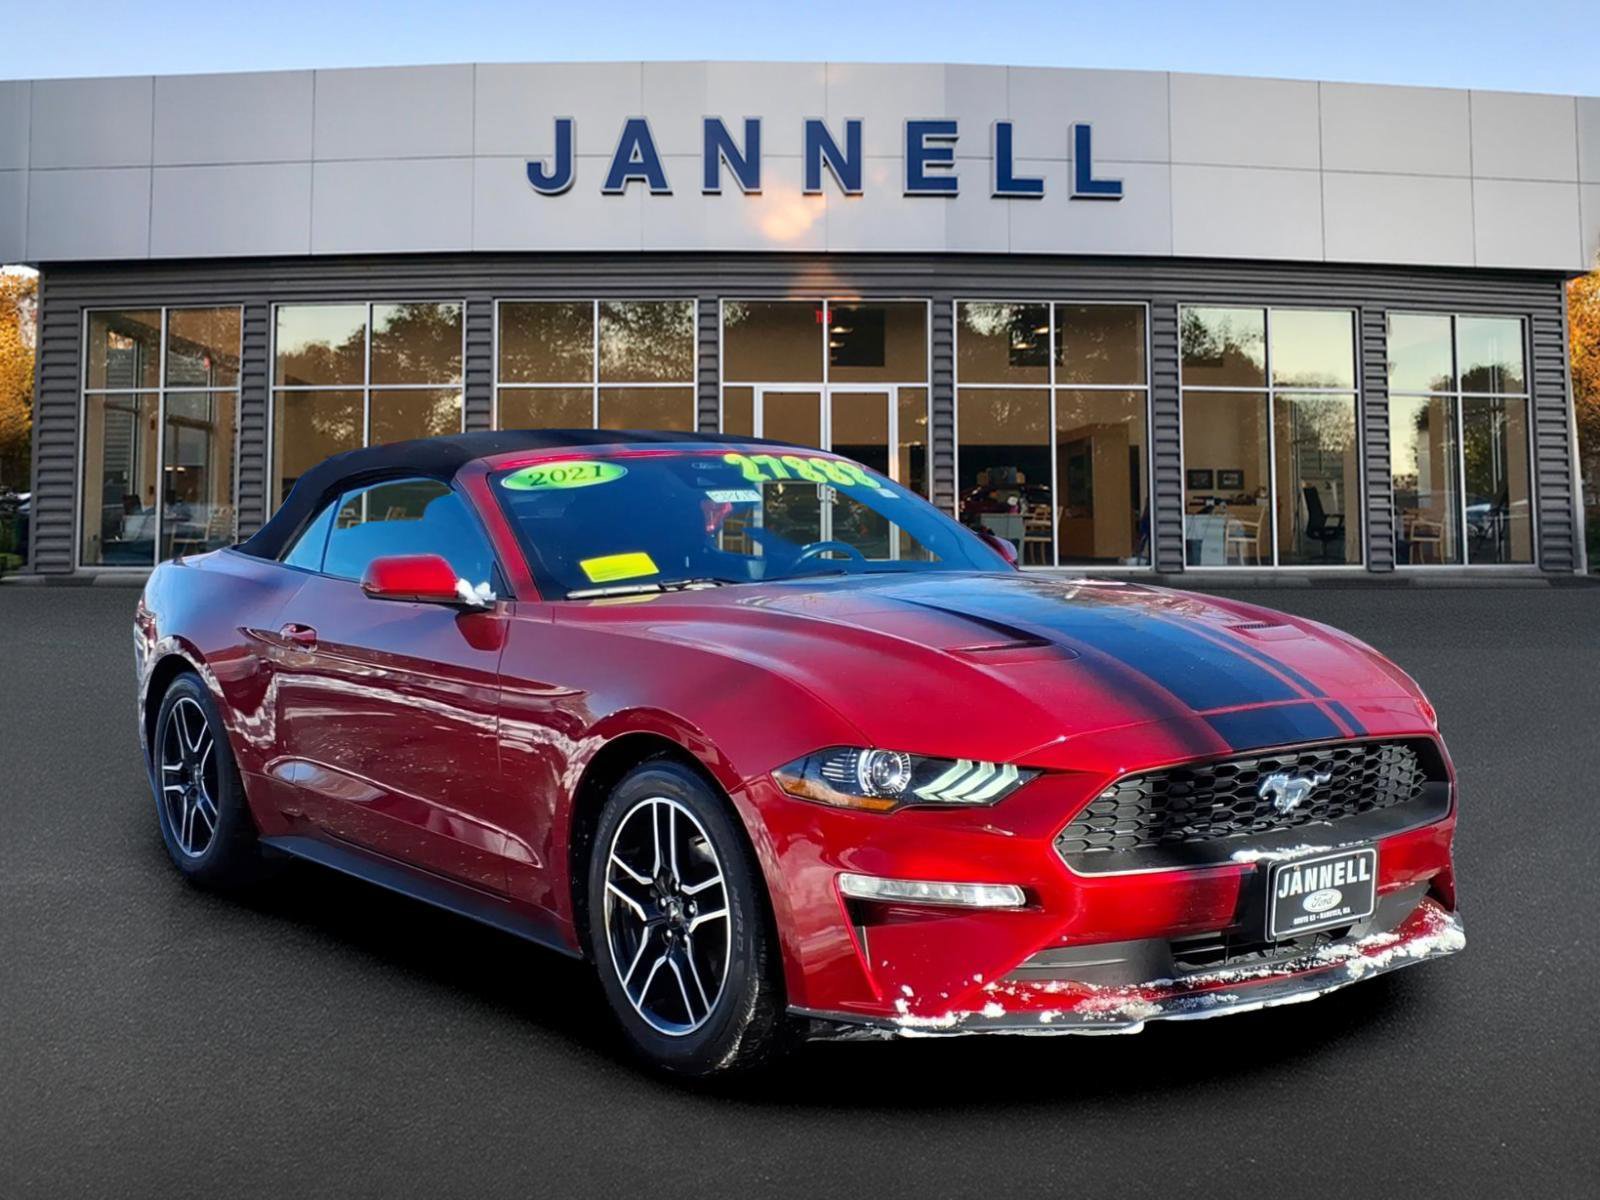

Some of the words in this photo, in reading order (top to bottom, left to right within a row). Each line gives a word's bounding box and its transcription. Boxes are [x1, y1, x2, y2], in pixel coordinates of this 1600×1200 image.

[525, 115, 1124, 199] JANNELL
[527, 465, 603, 487] 2021
[1278, 857, 1370, 898] JANNELL
